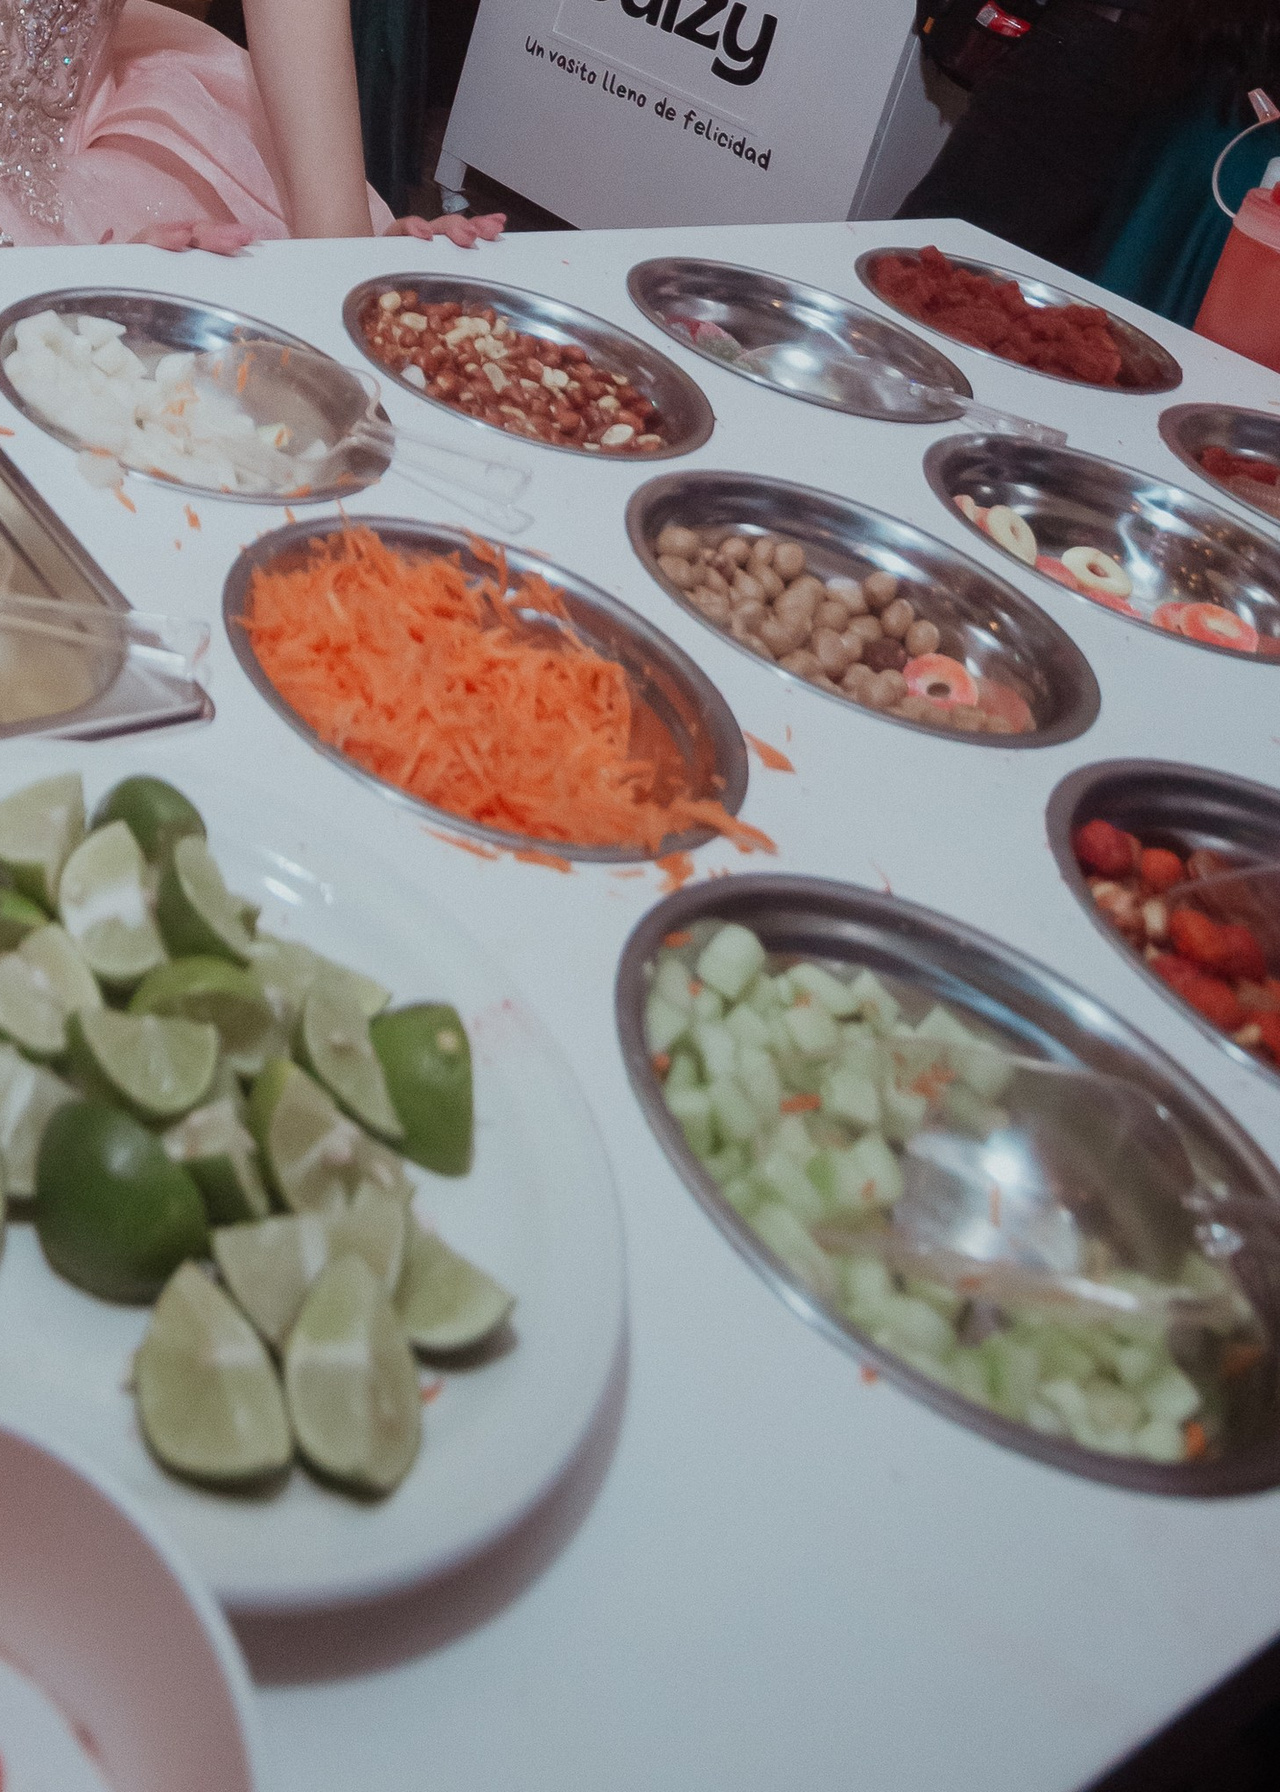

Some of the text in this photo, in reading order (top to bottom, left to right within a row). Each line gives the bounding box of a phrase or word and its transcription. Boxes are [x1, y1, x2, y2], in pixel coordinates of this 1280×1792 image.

[525, 35, 772, 171] Un vasito lleno de felicidad
